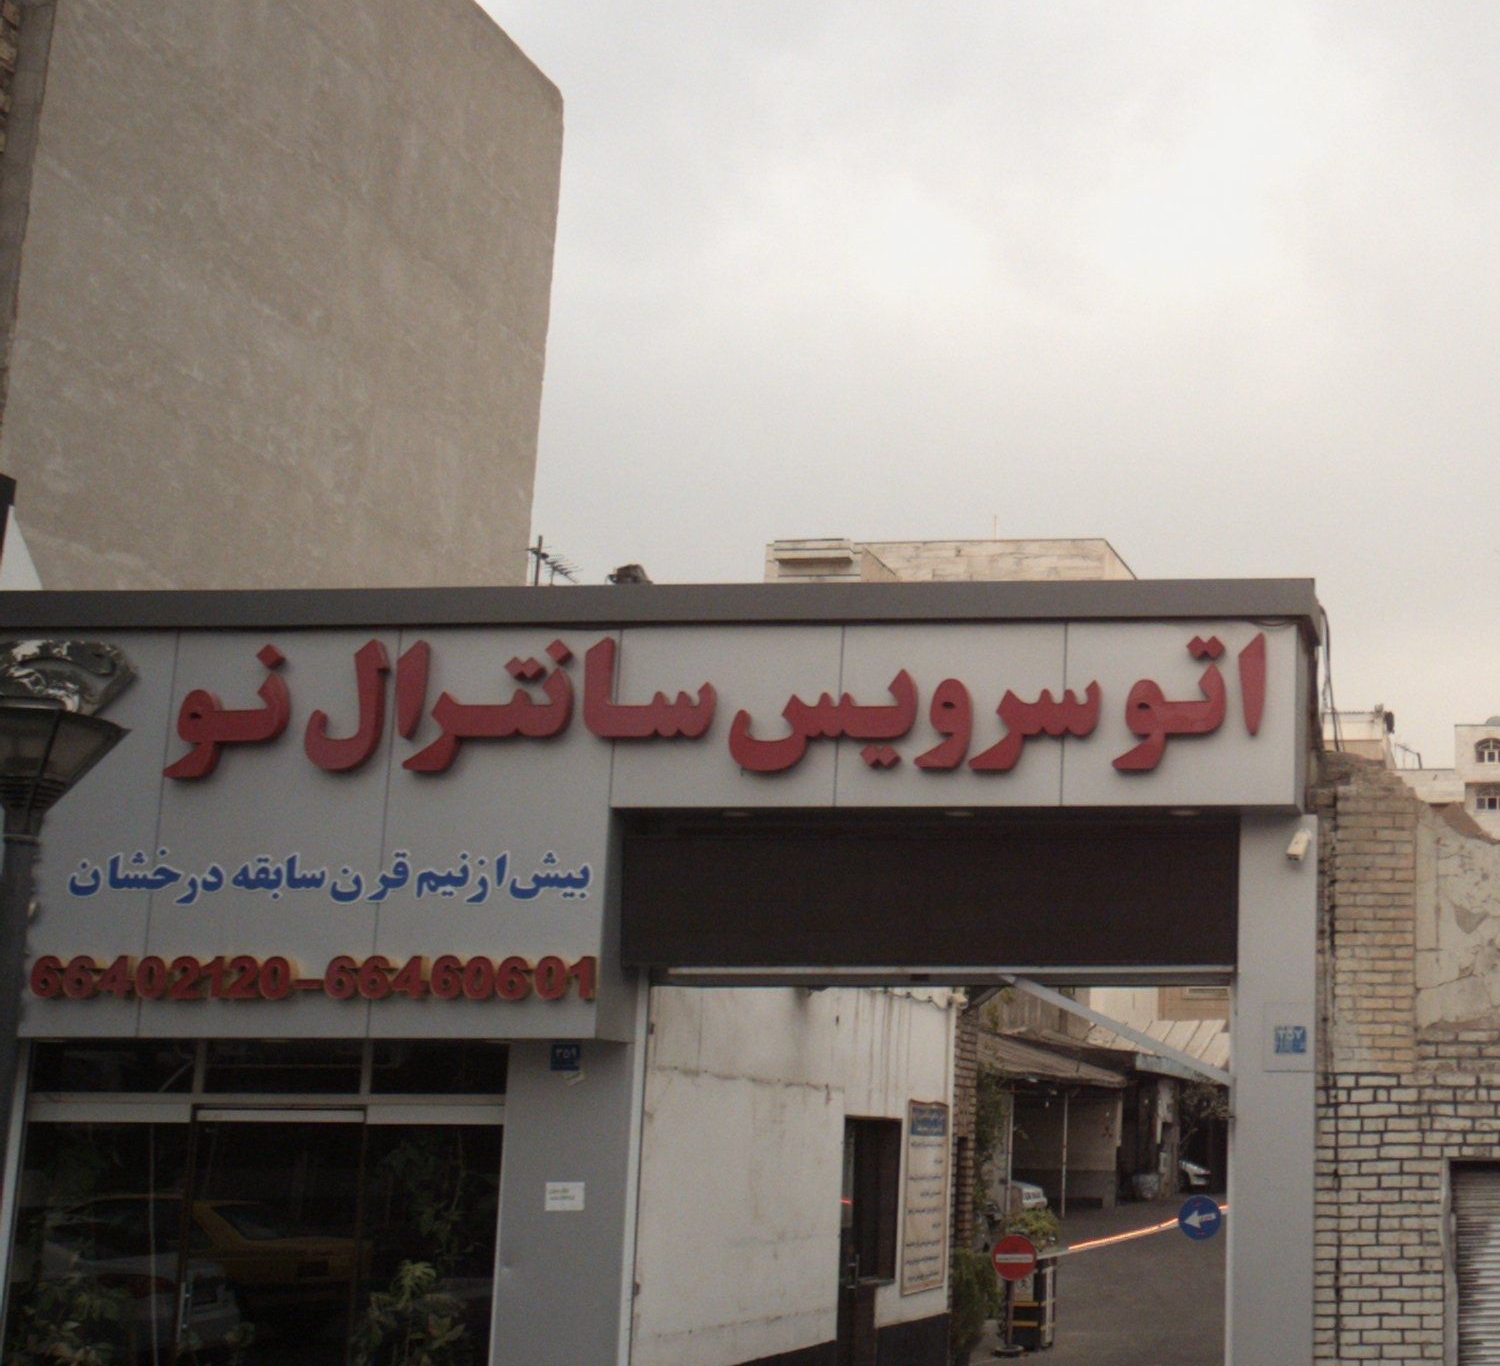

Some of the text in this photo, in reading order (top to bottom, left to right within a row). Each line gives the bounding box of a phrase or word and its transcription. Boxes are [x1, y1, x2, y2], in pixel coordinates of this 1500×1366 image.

[163, 644, 290, 779] نو
[305, 637, 717, 773] سانترال
[68, 848, 591, 904] بیش از نیم قرن سابقه درخشان
